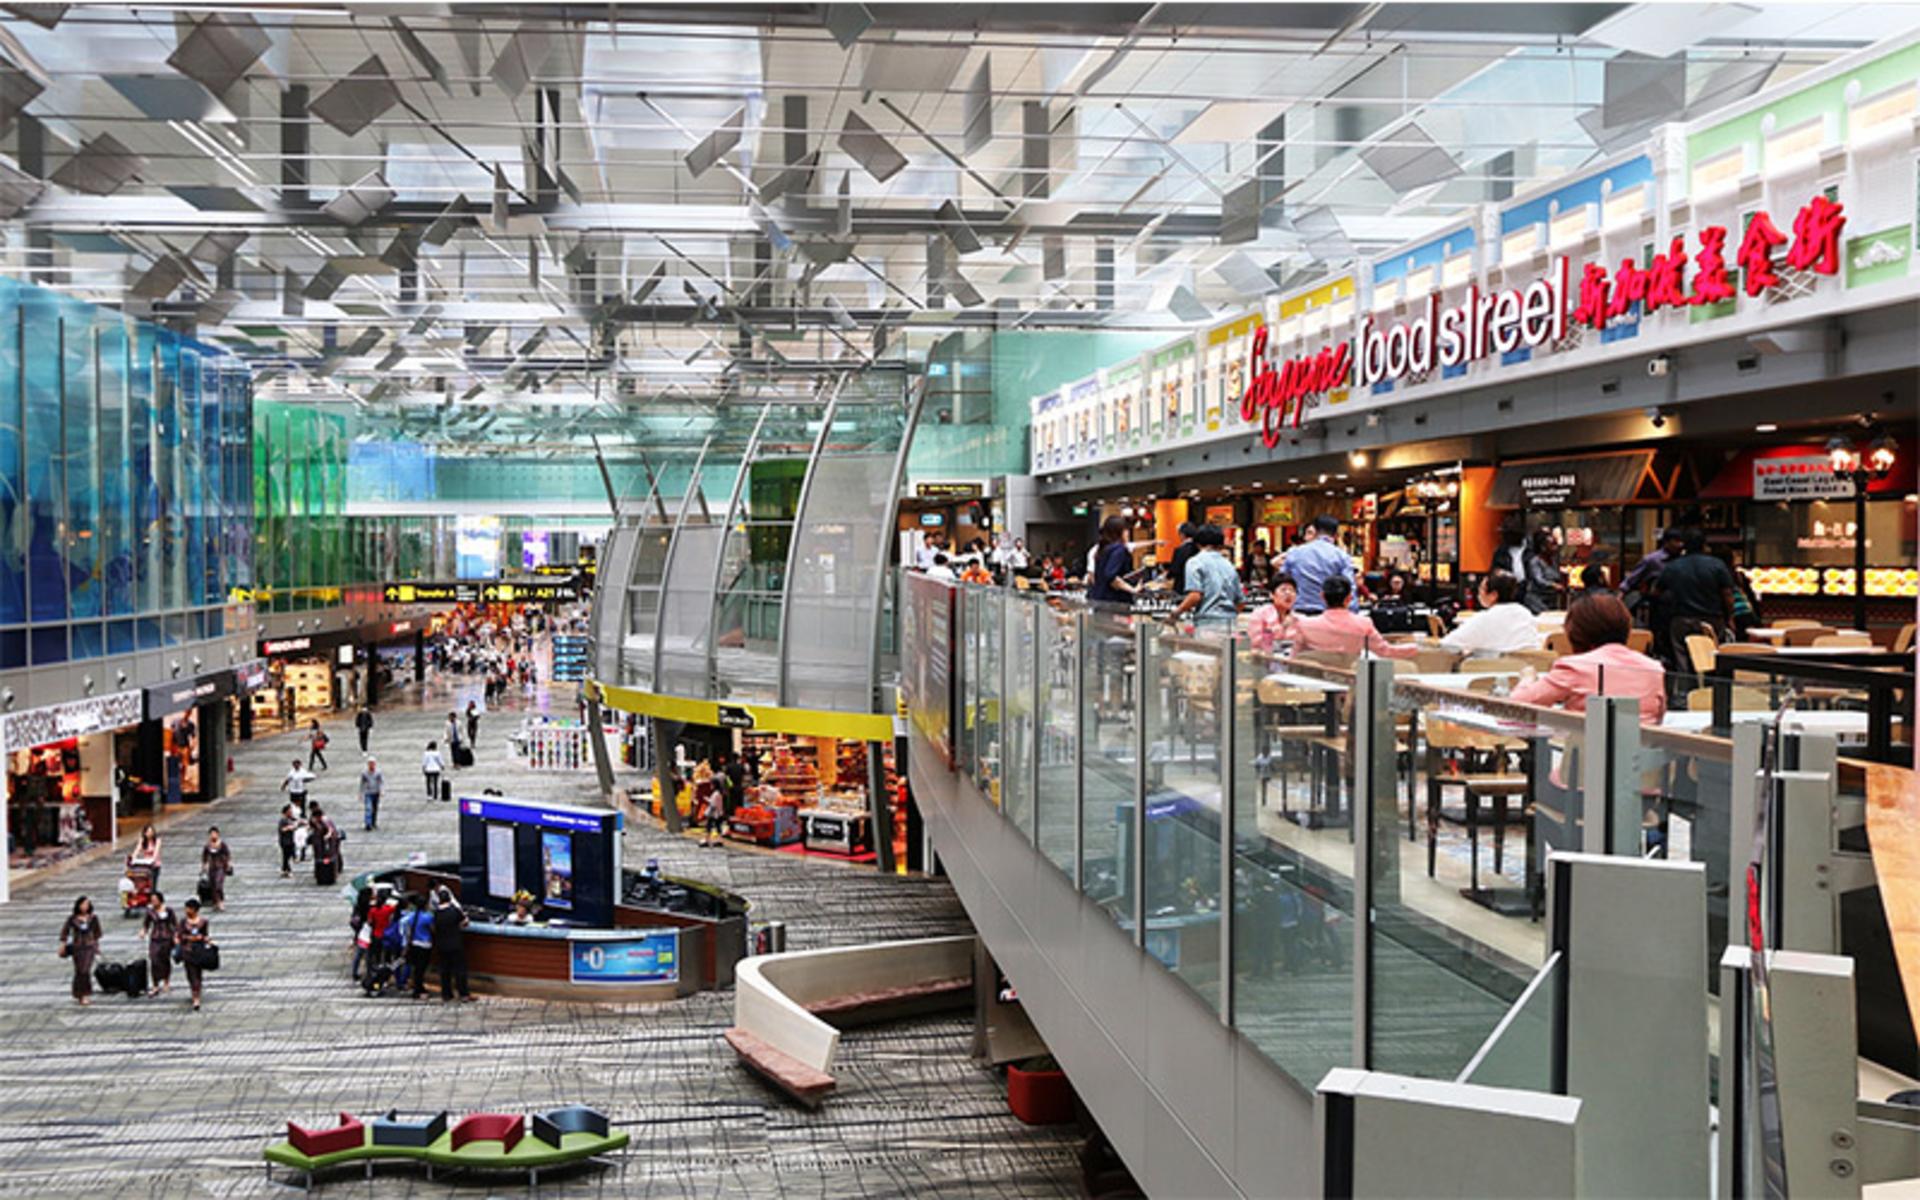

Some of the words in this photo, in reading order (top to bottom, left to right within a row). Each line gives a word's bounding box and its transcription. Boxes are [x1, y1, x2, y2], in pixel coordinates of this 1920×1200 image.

[1574, 196, 1847, 330] 新加坡美食街
[1241, 326, 1352, 448] Singapore
[1354, 294, 1439, 388] food
[1440, 256, 1570, 366] street
